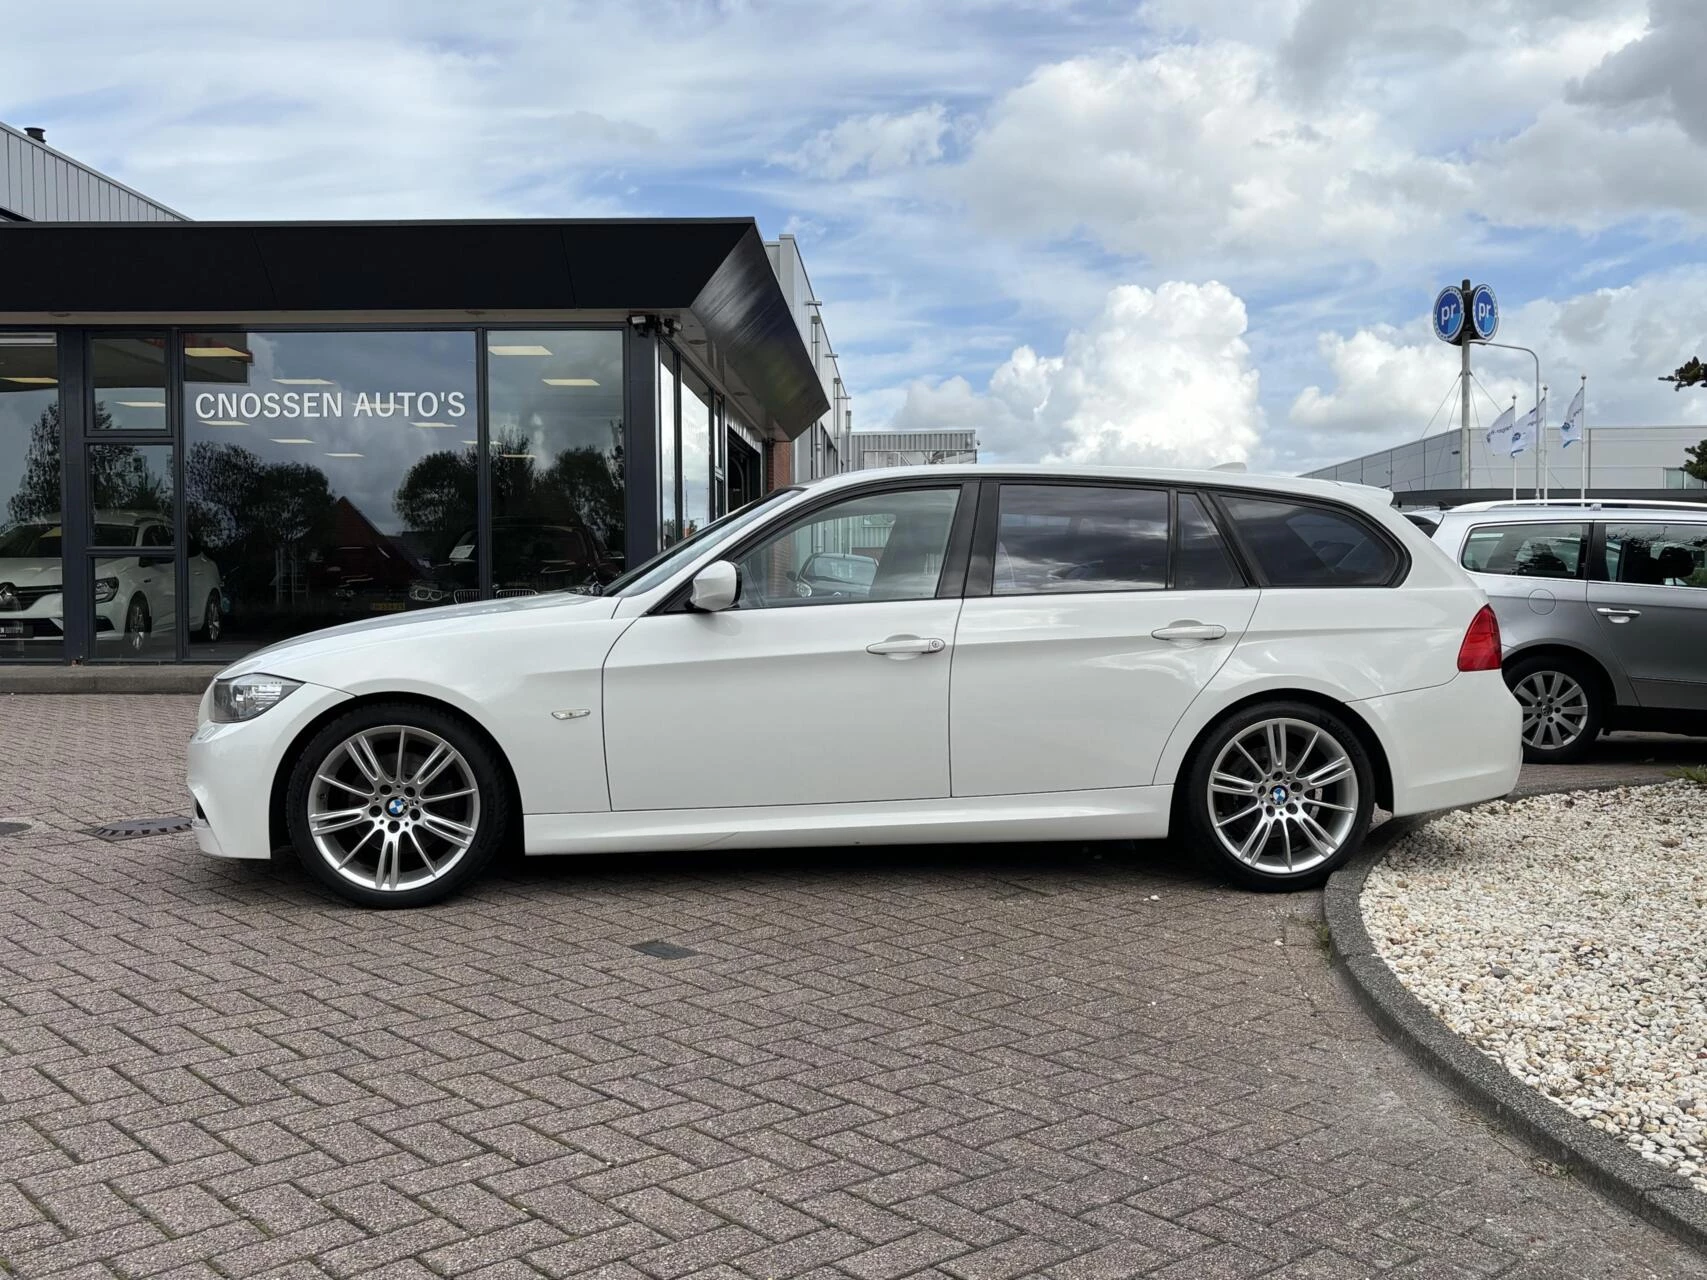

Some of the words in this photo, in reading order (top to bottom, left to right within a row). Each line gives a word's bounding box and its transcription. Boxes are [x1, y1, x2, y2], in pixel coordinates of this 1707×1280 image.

[1441, 303, 1457, 326] pr
[1478, 302, 1492, 321] pr
[195, 392, 342, 418] CNOSSEN
[353, 391, 466, 418] AUTO'S
